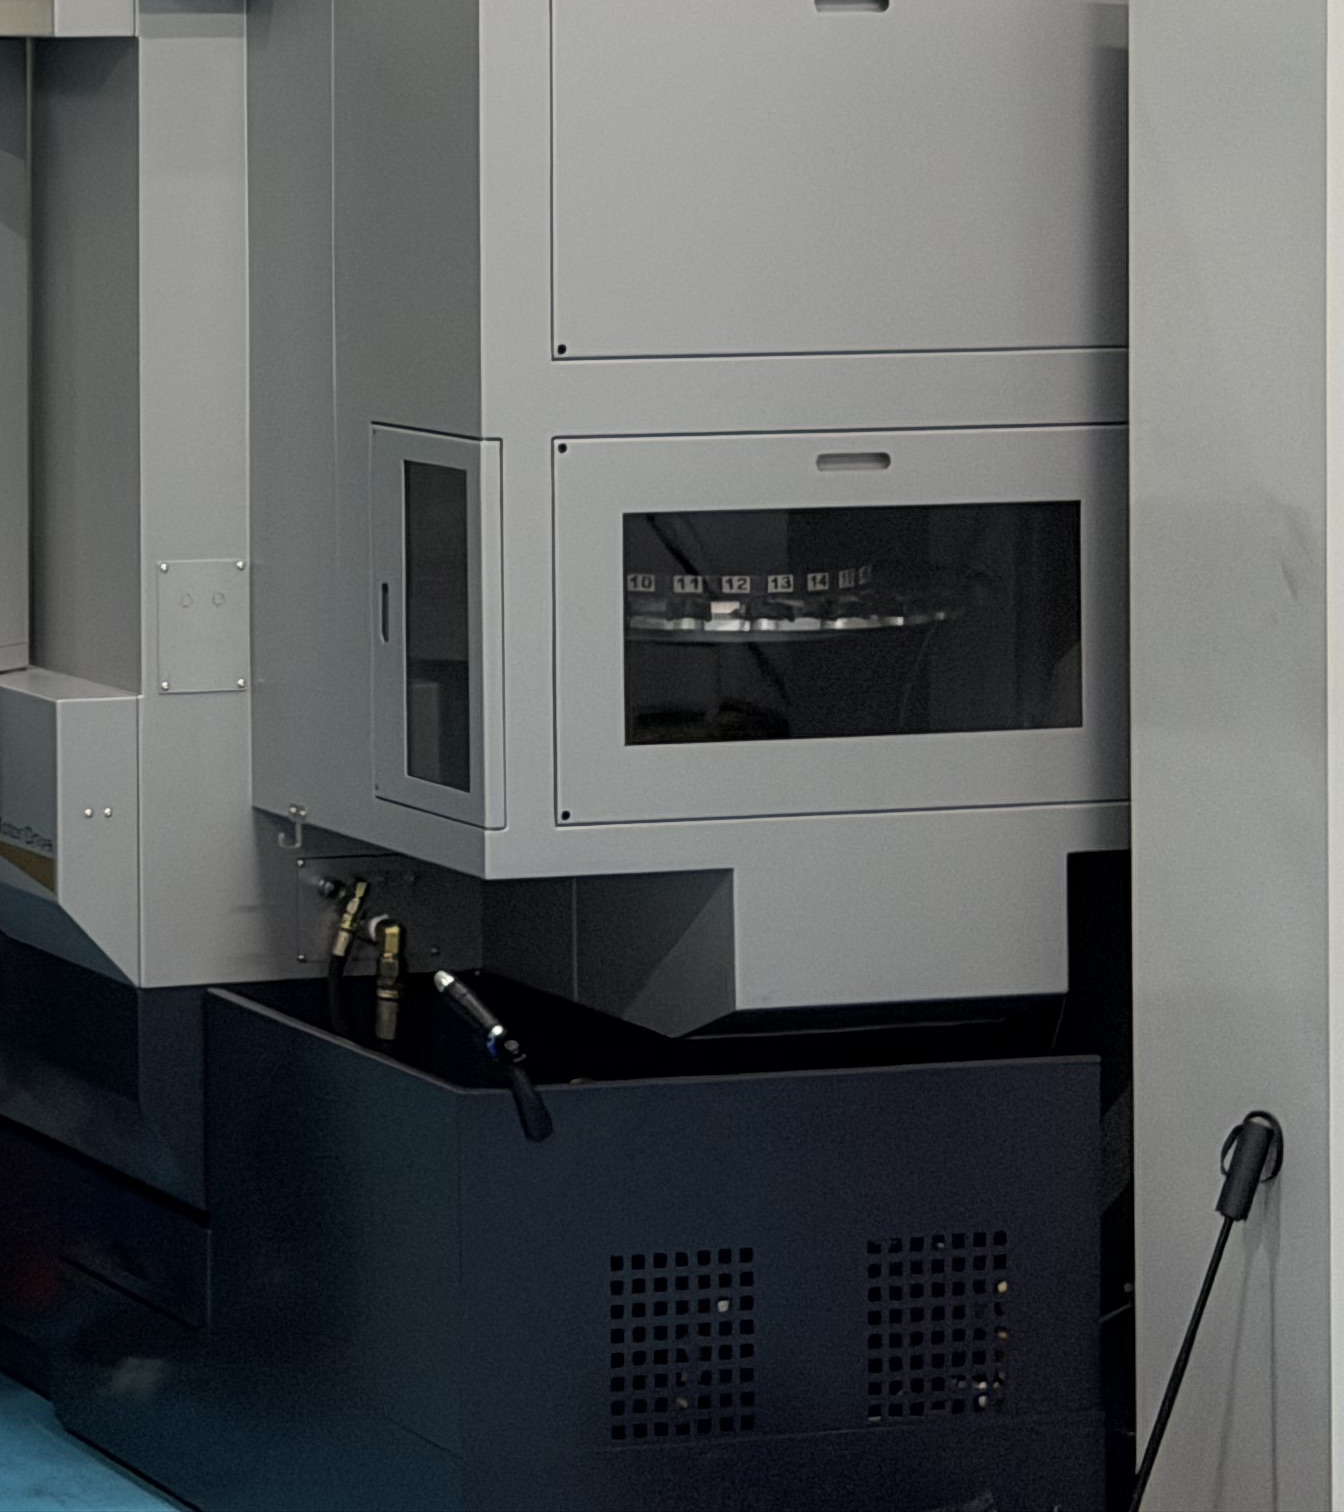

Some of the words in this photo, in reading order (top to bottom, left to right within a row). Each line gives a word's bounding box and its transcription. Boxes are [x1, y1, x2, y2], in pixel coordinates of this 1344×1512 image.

[629, 575, 653, 590] 10
[676, 577, 701, 592] 11
[723, 577, 749, 592] 12
[770, 576, 792, 591] 13
[810, 574, 828, 590] 14
